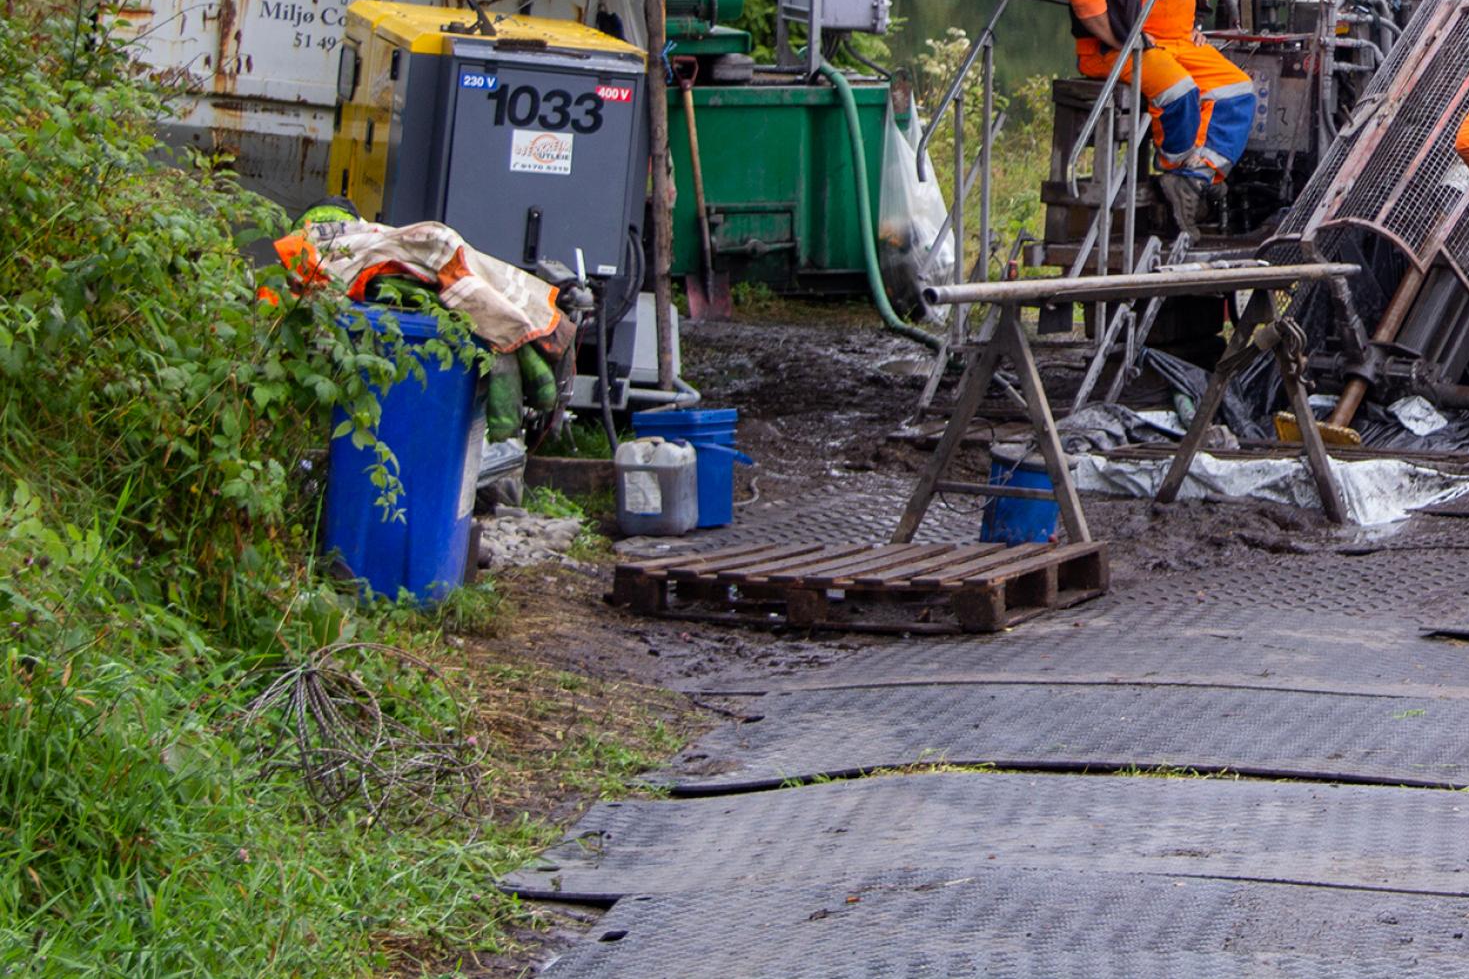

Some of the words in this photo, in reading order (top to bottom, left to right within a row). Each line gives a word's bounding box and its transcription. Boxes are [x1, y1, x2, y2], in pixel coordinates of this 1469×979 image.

[260, 1, 315, 27] Miljø
[293, 30, 312, 49] 51
[463, 75, 484, 87] 230
[486, 76, 496, 88] V
[598, 86, 617, 99] 400
[619, 89, 630, 101] V
[487, 83, 605, 135] 1033
